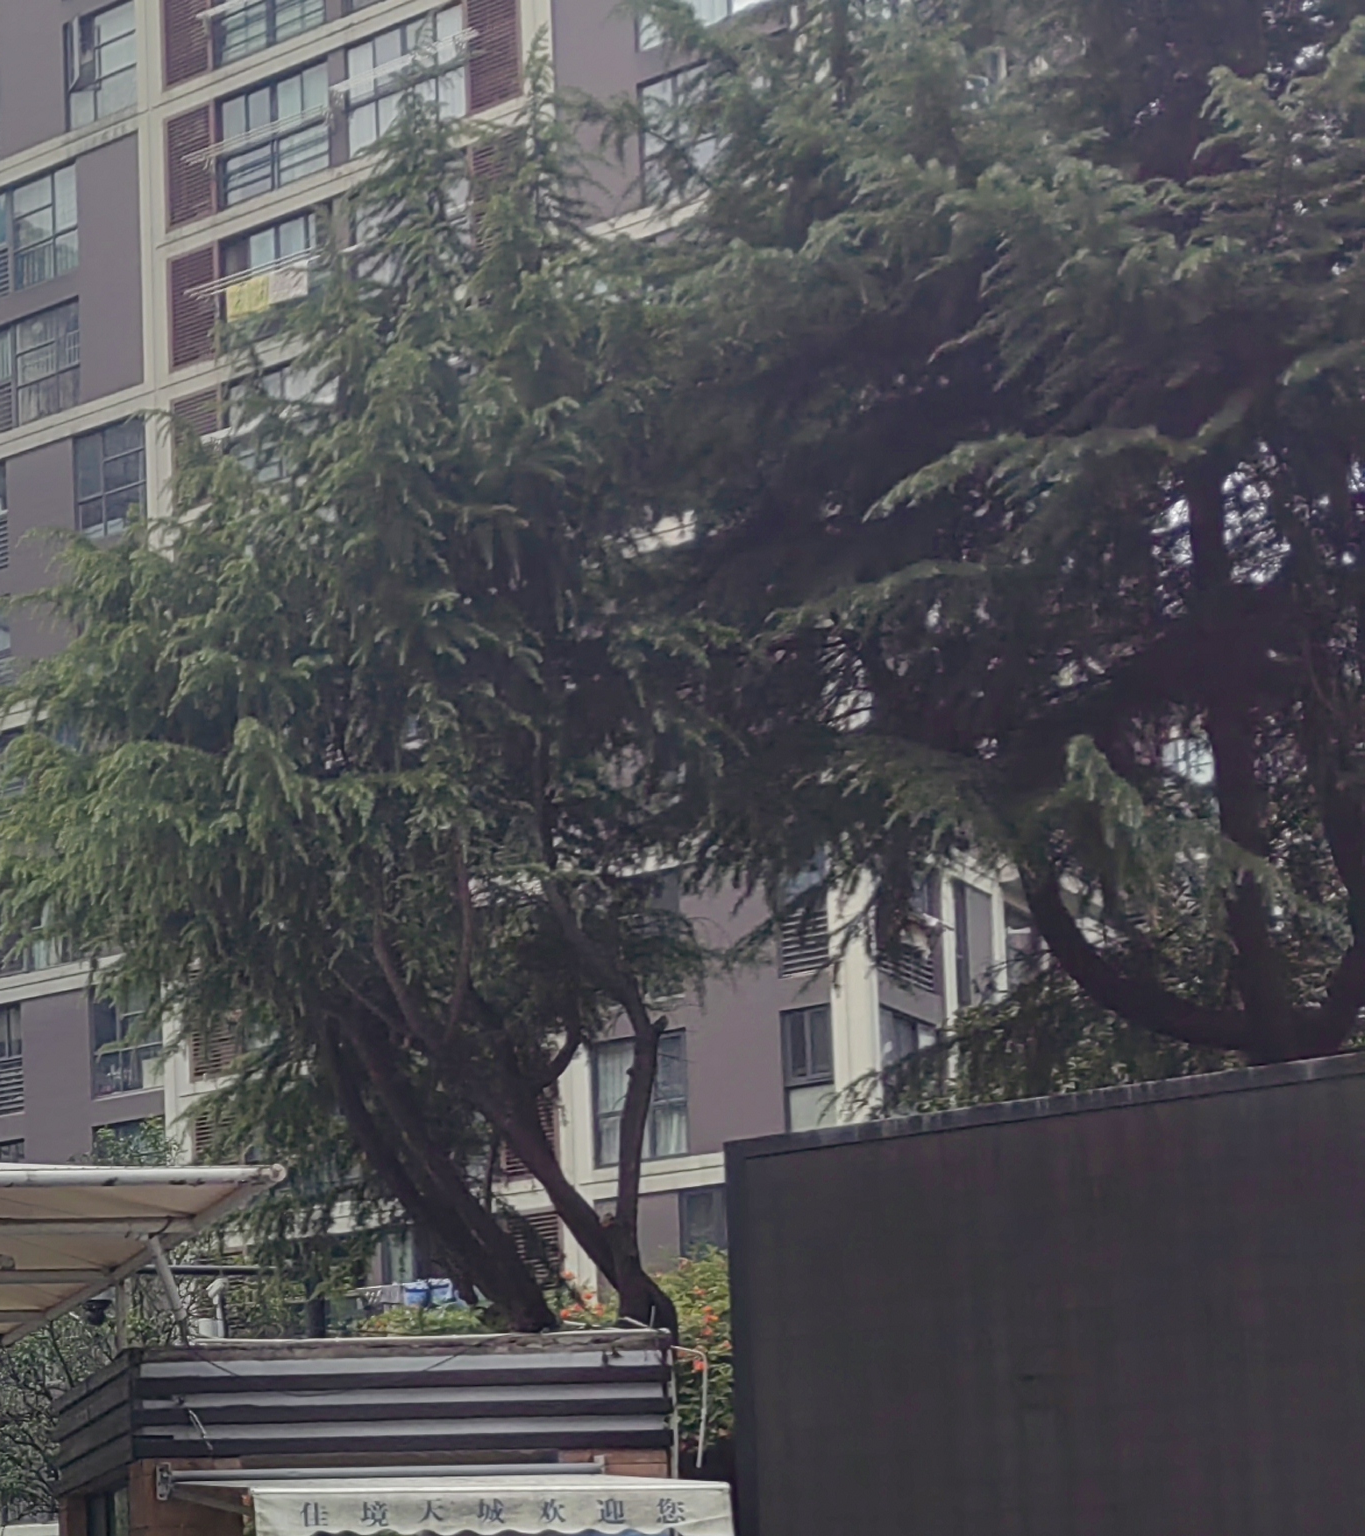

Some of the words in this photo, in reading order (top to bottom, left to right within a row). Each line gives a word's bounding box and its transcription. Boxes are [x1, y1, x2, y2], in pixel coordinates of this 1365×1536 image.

[300, 1498, 685, 1528] 佳境天城欢迎您
